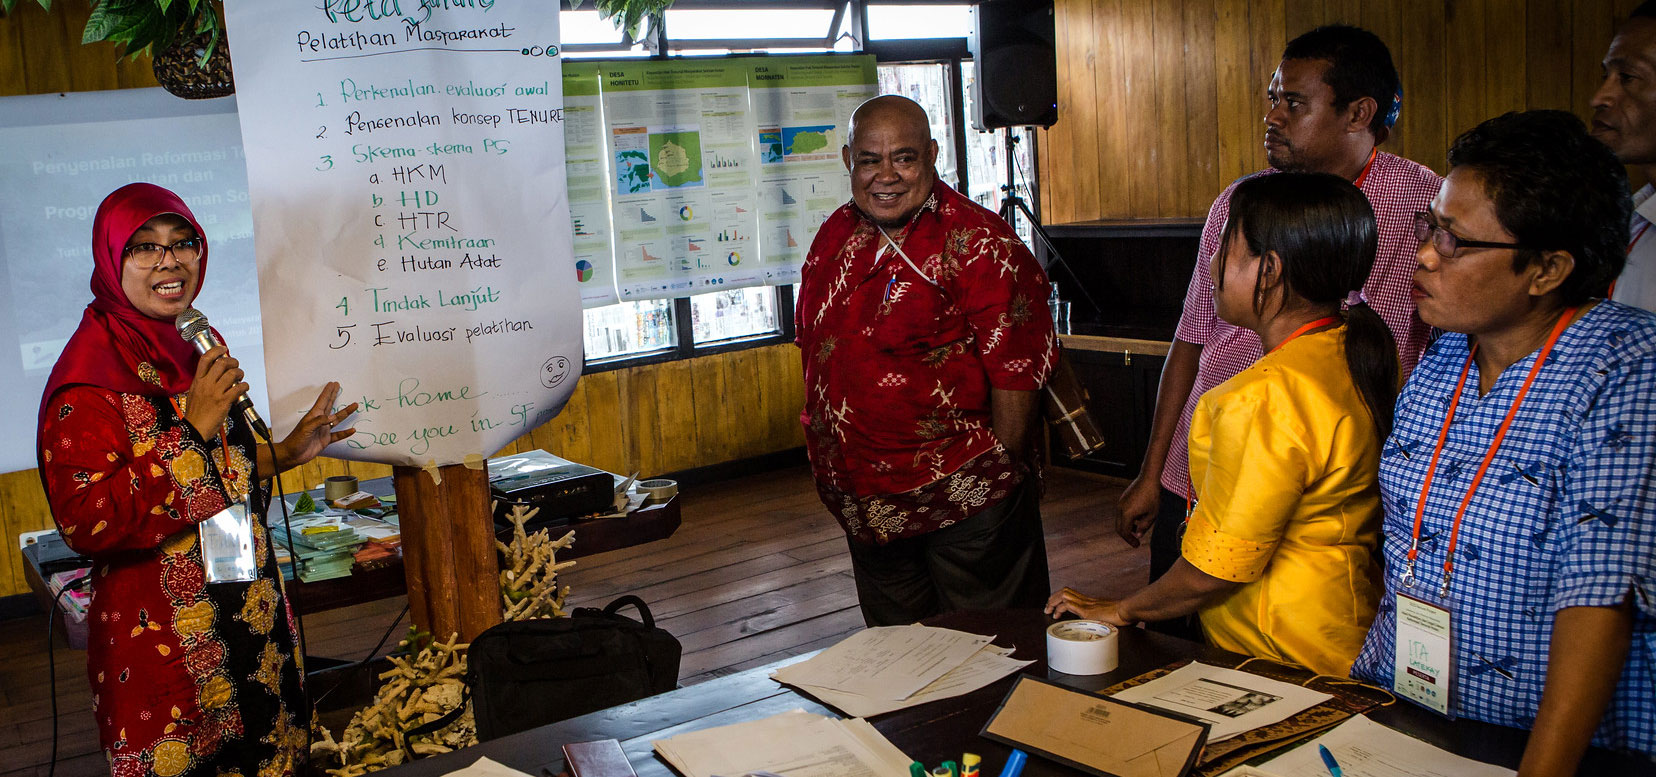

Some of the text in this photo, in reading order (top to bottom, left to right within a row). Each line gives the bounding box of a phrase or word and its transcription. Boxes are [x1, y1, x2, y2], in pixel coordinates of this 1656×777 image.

[298, 31, 396, 53] Pelatihan
[446, 80, 508, 97] evaluasi
[515, 81, 548, 96] awal
[452, 107, 501, 129] konsep
[506, 108, 563, 124] TENURE
[142, 148, 227, 167] Reformasi
[483, 139, 511, 155] PS
[183, 169, 214, 183] dan
[392, 164, 448, 186] HKM
[395, 190, 439, 209] HD
[397, 211, 459, 232] HTR
[397, 229, 496, 251] Kemitraan
[401, 255, 452, 272] Hutan
[460, 253, 503, 270] Adat
[365, 288, 430, 314] Tindak
[438, 286, 501, 311] Lanjut
[371, 321, 457, 347] Evaluasi
[466, 318, 534, 344] pelatihan
[386, 377, 488, 409] home
[346, 419, 400, 450] See
[407, 422, 459, 456] you
[471, 411, 504, 432] in
[1408, 639, 1430, 662] ITA
